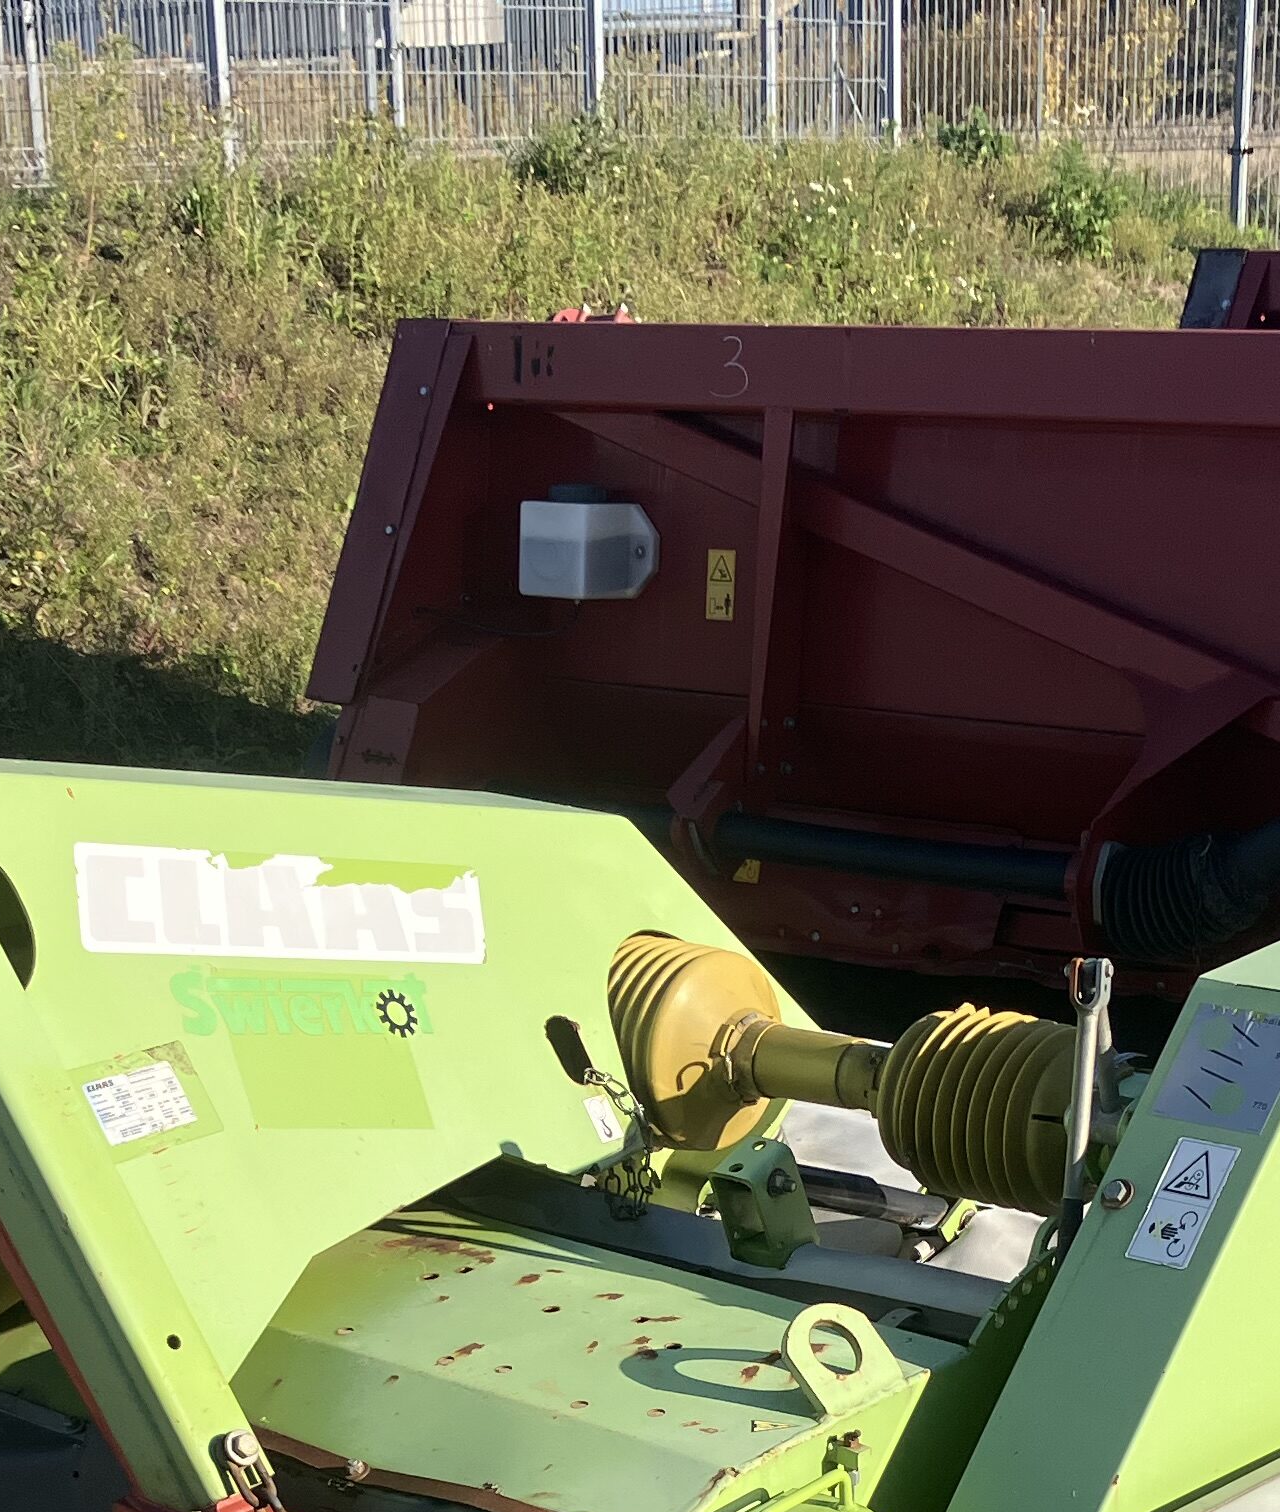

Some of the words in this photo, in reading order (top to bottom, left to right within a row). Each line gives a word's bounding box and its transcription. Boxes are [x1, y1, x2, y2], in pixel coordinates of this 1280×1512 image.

[710, 336, 749, 398] 3
[85, 854, 477, 954] CLAAS
[86, 1079, 115, 1093] CLAAS
